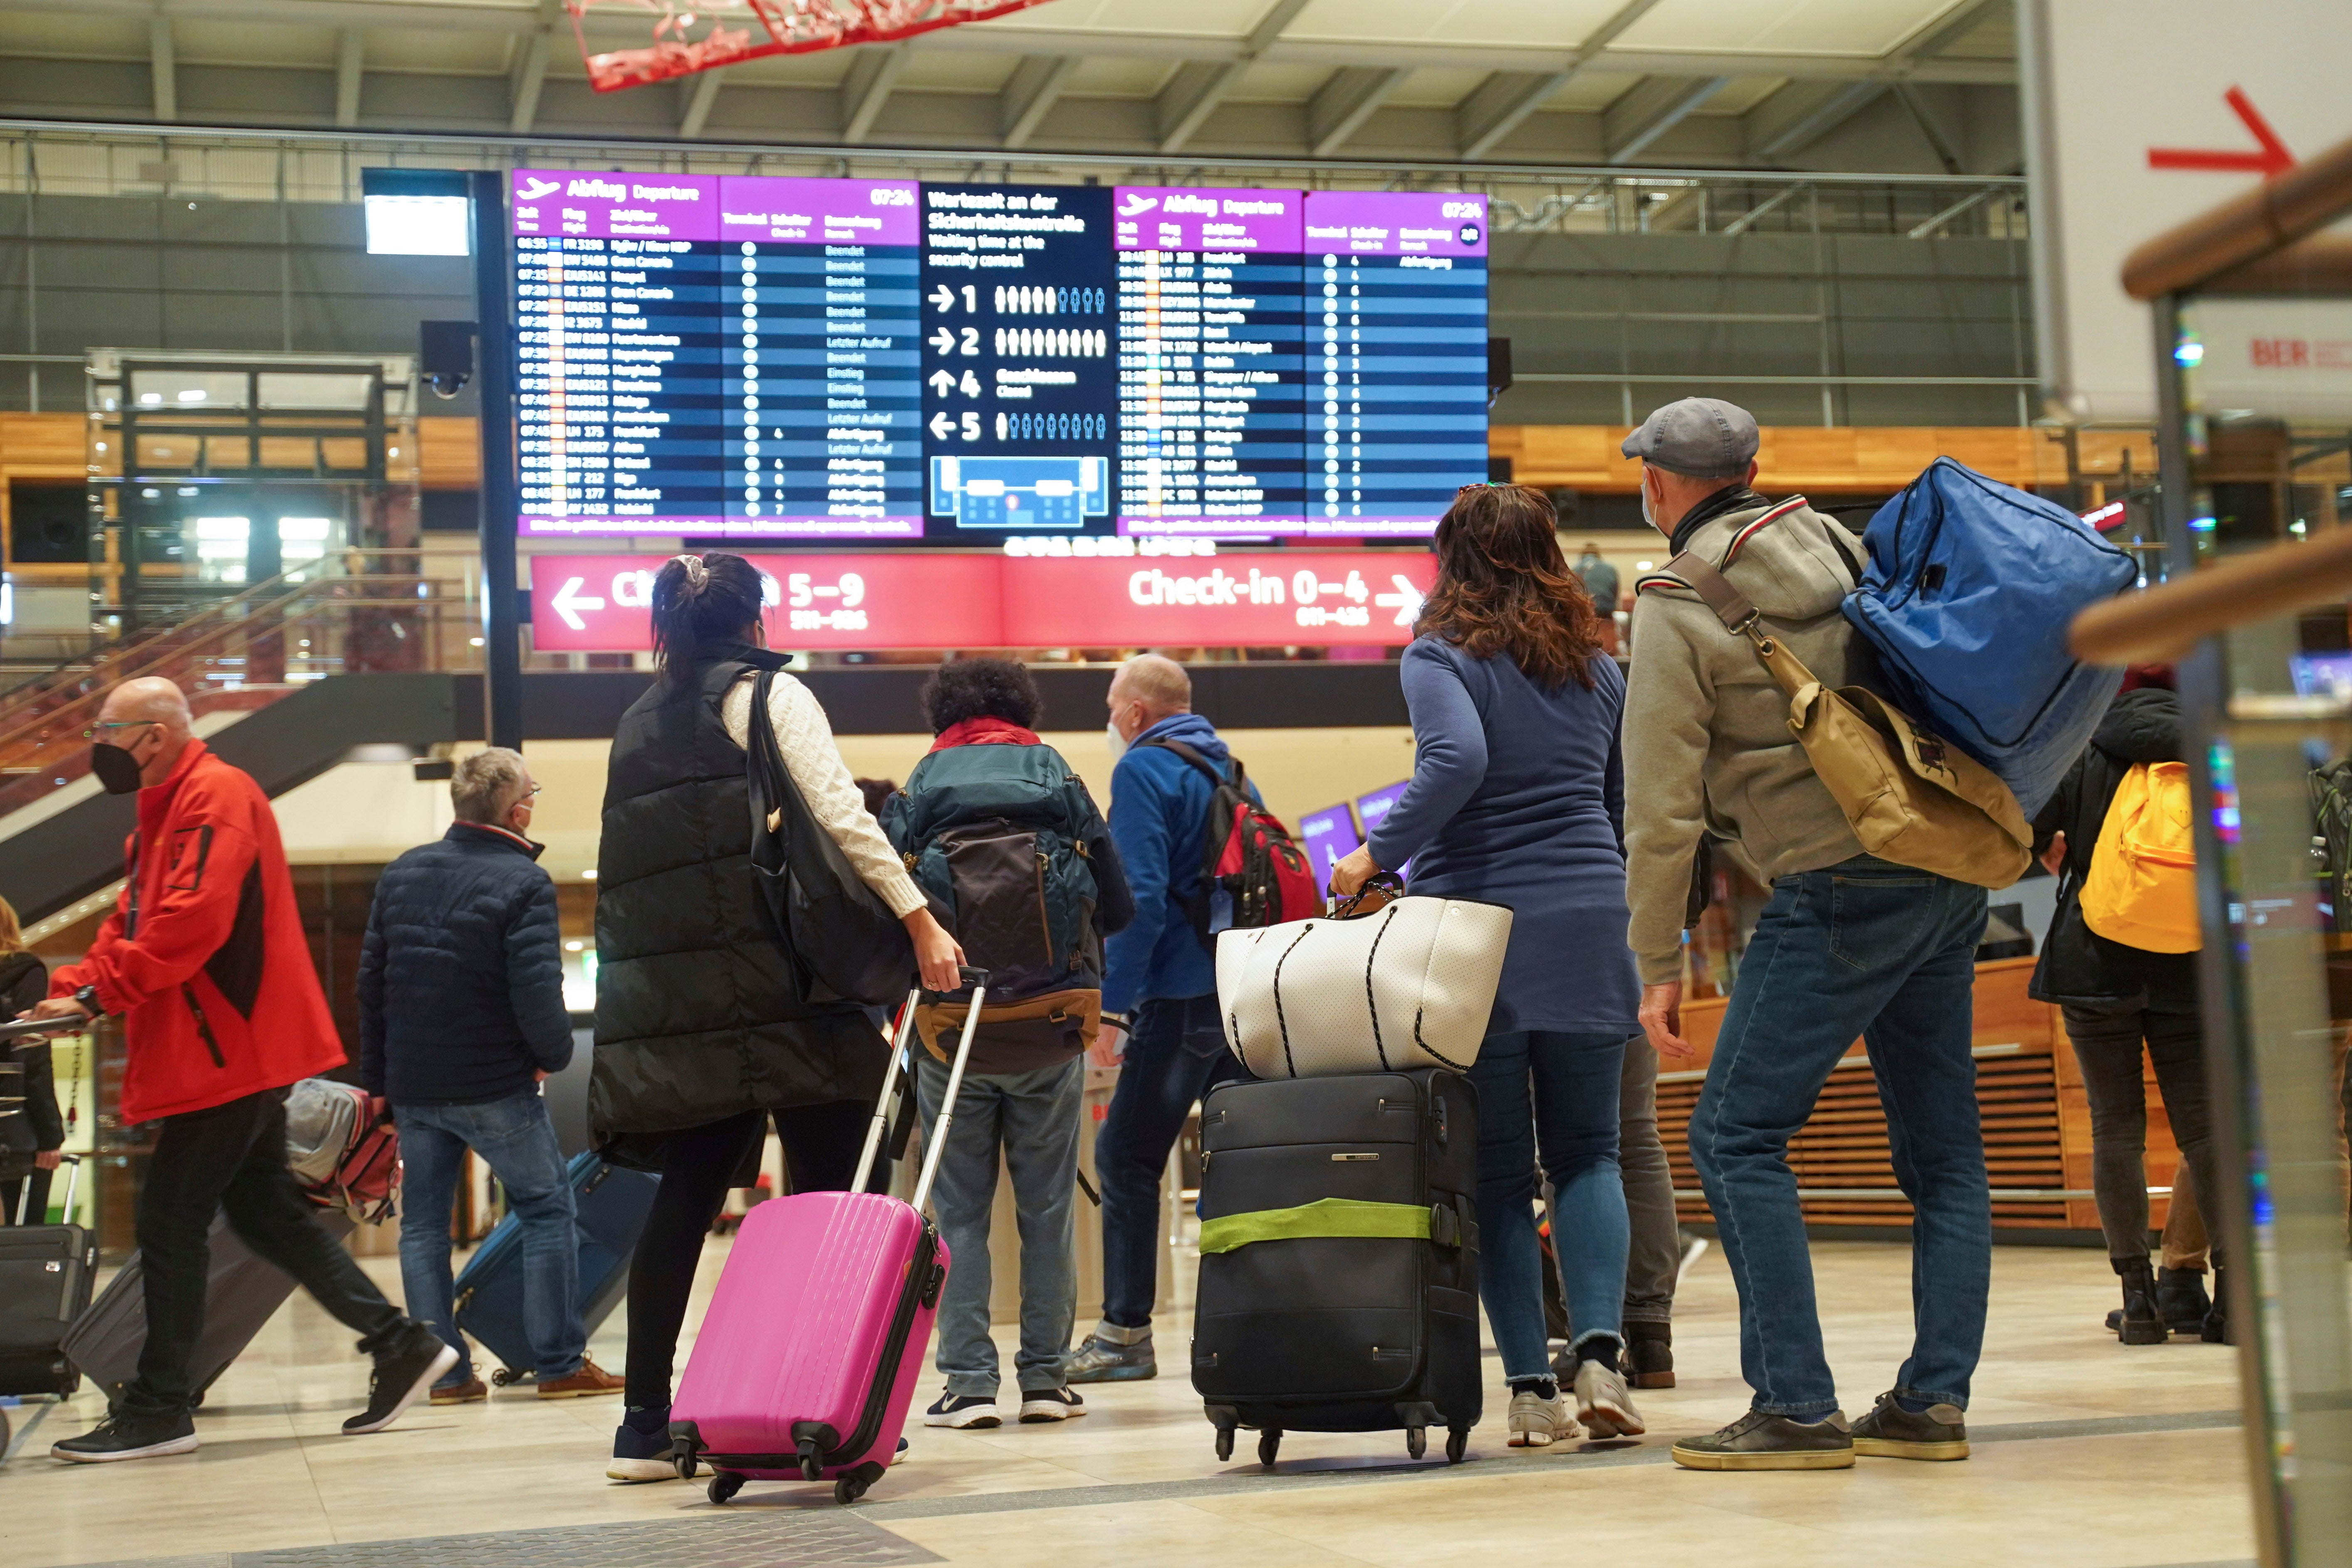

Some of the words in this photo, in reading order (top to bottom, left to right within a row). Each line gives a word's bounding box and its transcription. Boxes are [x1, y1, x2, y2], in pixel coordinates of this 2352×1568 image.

[567, 179, 626, 202] Abflug
[633, 185, 699, 202] Departure
[871, 189, 914, 206] 07:24
[928, 192, 1005, 208] Wartezeit
[1007, 196, 1027, 209] an
[1030, 193, 1057, 210] der
[1163, 195, 1218, 218] Abflug
[1223, 200, 1284, 216] Departure
[1442, 202, 1483, 218] 07:24
[928, 212, 1084, 232] Sicherheitskontrolle
[928, 234, 976, 250] Waiting
[977, 234, 1006, 248] time
[1008, 236, 1021, 248] at
[1023, 235, 1045, 249] the
[826, 245, 864, 255] Beendet
[826, 261, 864, 271] Beendet
[929, 253, 978, 269] security
[980, 253, 1024, 267] control
[518, 269, 548, 280] 07:15
[826, 276, 864, 287] Beendet
[826, 291, 865, 302] Beendet
[962, 285, 975, 312] 1
[827, 307, 865, 317] Beendet
[827, 322, 865, 333] Beendet
[827, 338, 858, 347] Letzter
[860, 337, 891, 348] Aufruf
[961, 327, 978, 355] 2
[827, 352, 866, 363] Beendet
[827, 368, 864, 381] Einstieg
[827, 383, 864, 396] Einstieg
[960, 370, 980, 397] 4
[828, 398, 866, 409] Beendet
[828, 414, 860, 424] Letzter
[861, 413, 892, 424] Aufruf
[584, 426, 604, 437] 175
[962, 412, 980, 441] 5
[828, 444, 860, 454] Letzter
[860, 443, 893, 455] Aufruf
[585, 488, 605, 499] 177
[776, 504, 783, 515] 7
[1129, 568, 1285, 605] Check-in
